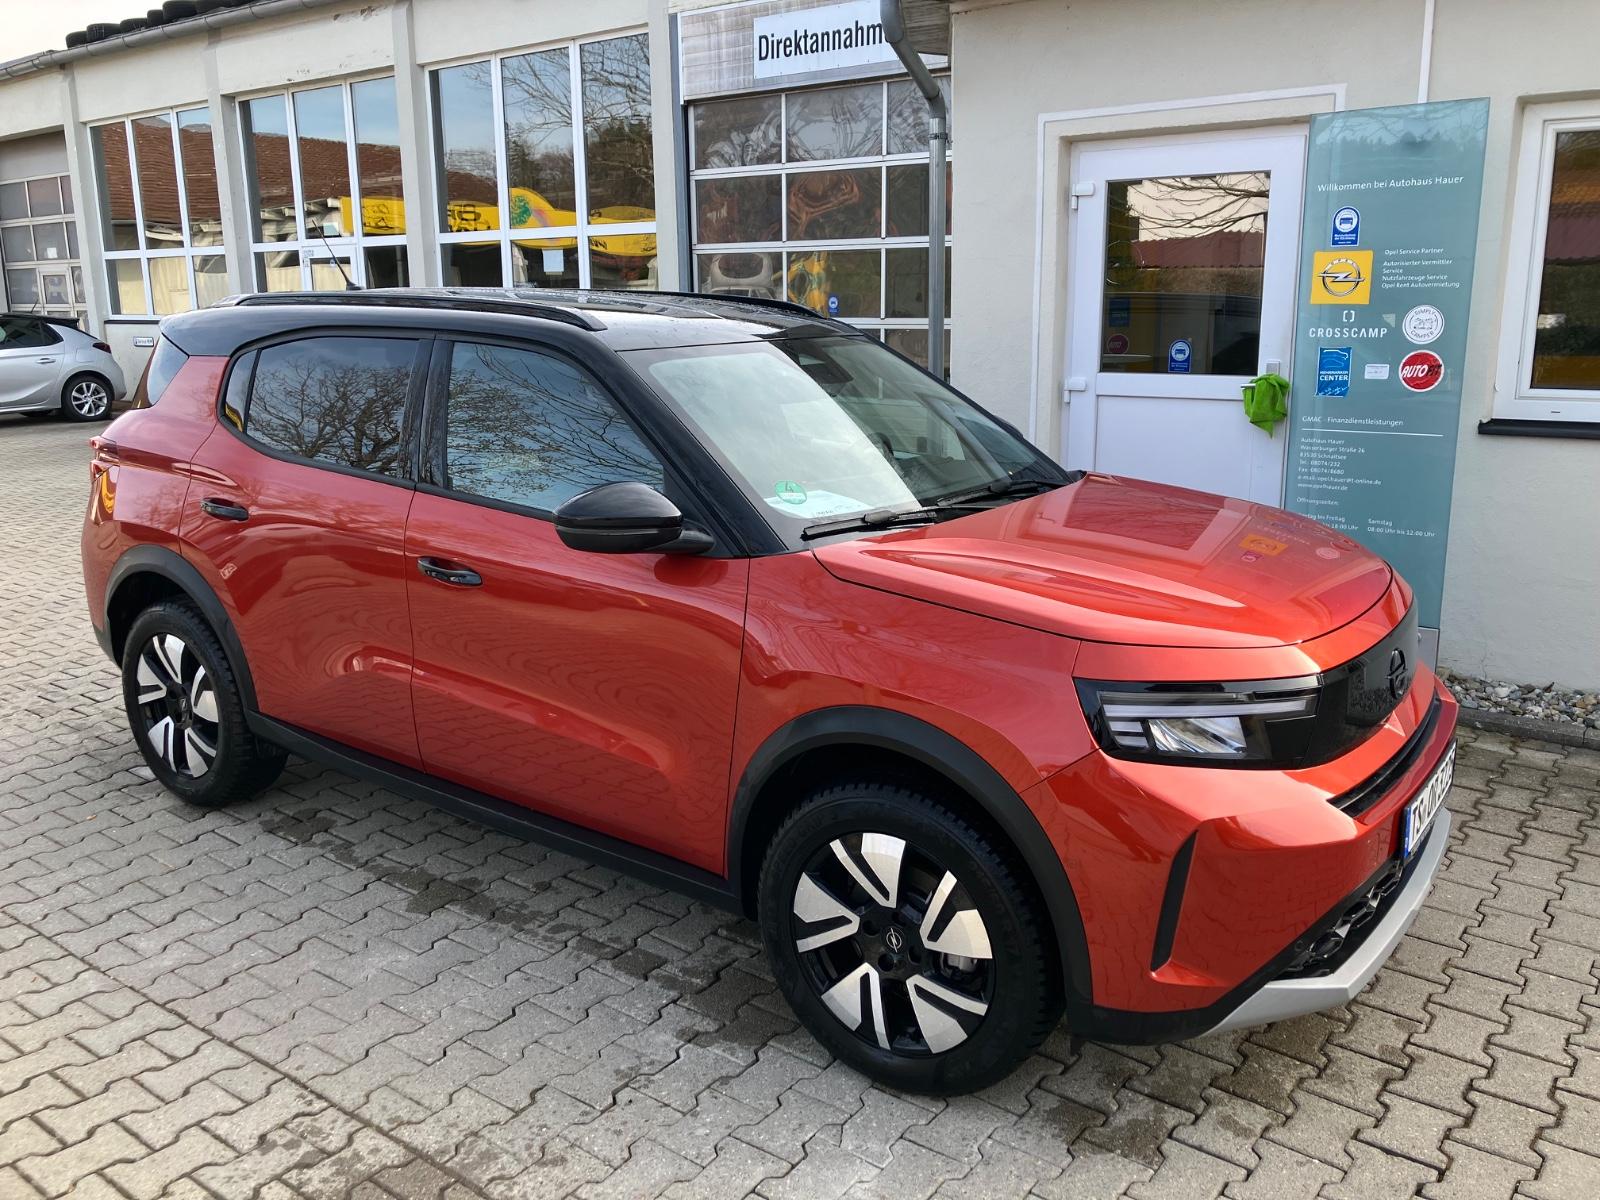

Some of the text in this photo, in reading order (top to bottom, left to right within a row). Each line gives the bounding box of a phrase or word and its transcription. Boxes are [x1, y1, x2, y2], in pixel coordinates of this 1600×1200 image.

[758, 20, 884, 61] Direktannahm
[1317, 175, 1464, 192] Willkommen bei Autohaus Hauer
[1410, 281, 1460, 289] Autovermietung
[1309, 327, 1387, 338] CROSSCAMP
[1411, 329, 1435, 338] CAMPER
[1302, 415, 1403, 427] GMAC Finanzdienstleistungen
[1368, 518, 1393, 526] Samstag
